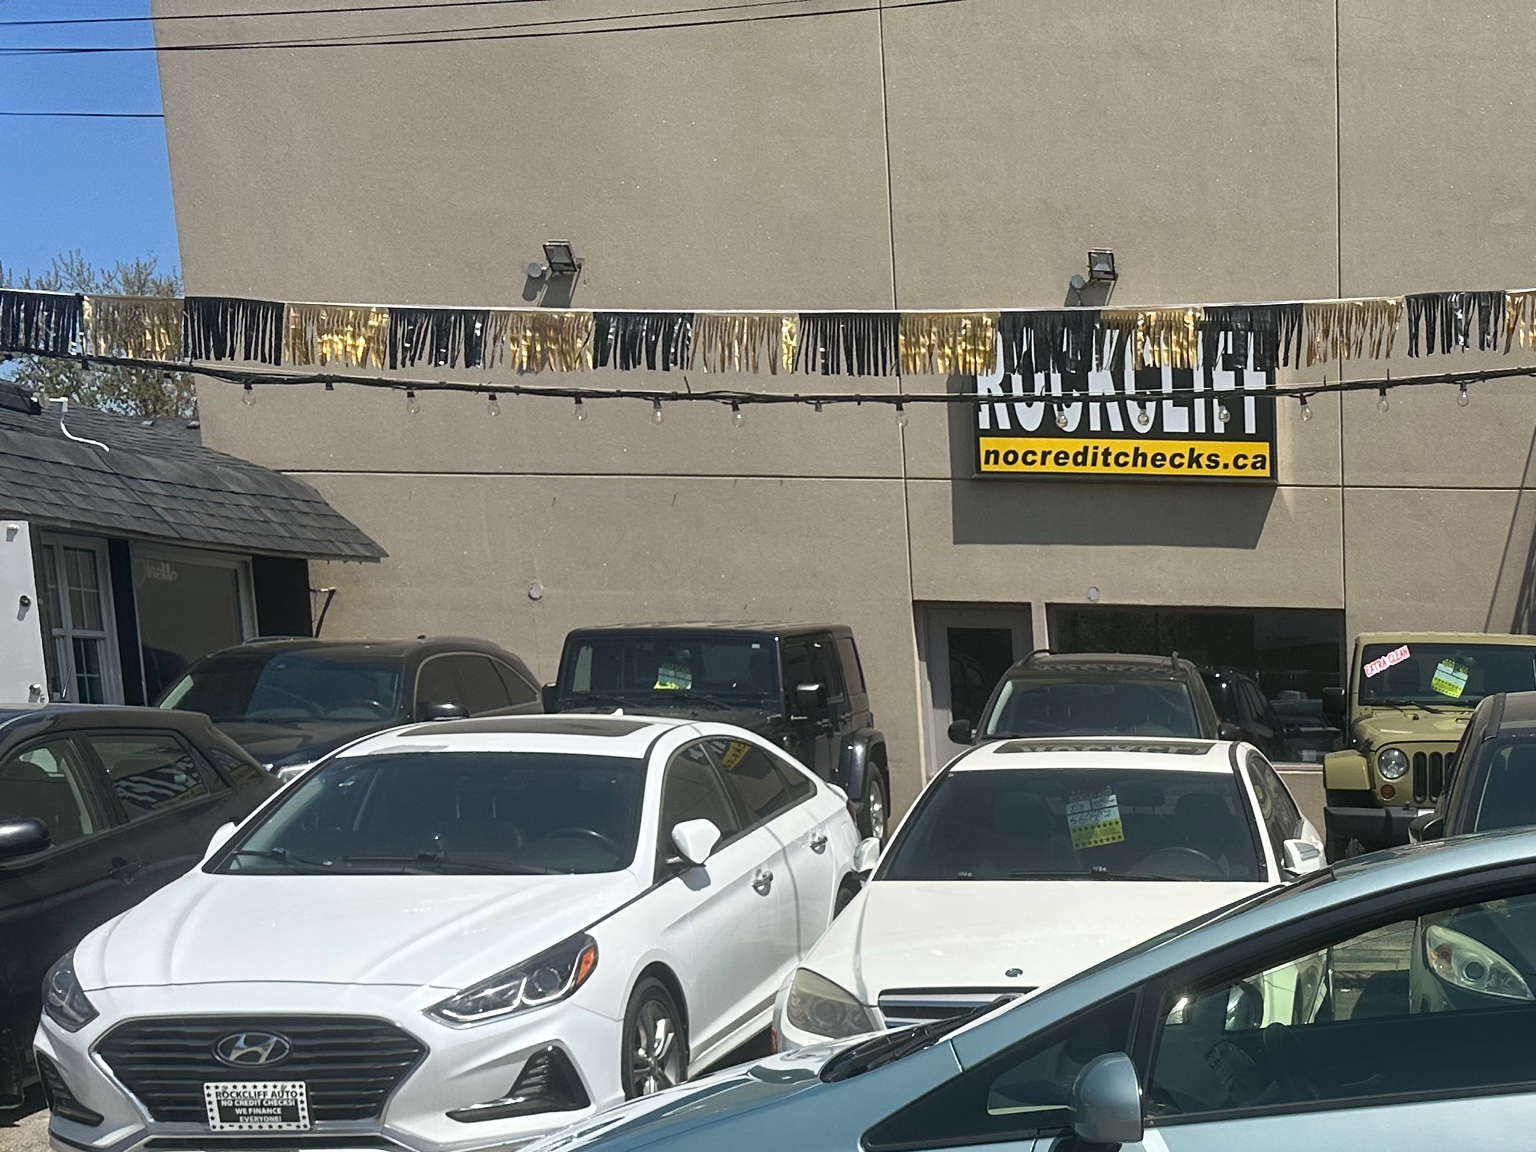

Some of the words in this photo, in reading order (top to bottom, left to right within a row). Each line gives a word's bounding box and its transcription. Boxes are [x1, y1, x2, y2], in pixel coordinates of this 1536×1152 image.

[983, 445, 1268, 472] nocreditchecks.ca
[215, 1090, 268, 1099] ROCKCLIFF
[271, 1090, 298, 1098] AUTO
[221, 1099, 233, 1107] NO
[235, 1107, 247, 1115] WE
